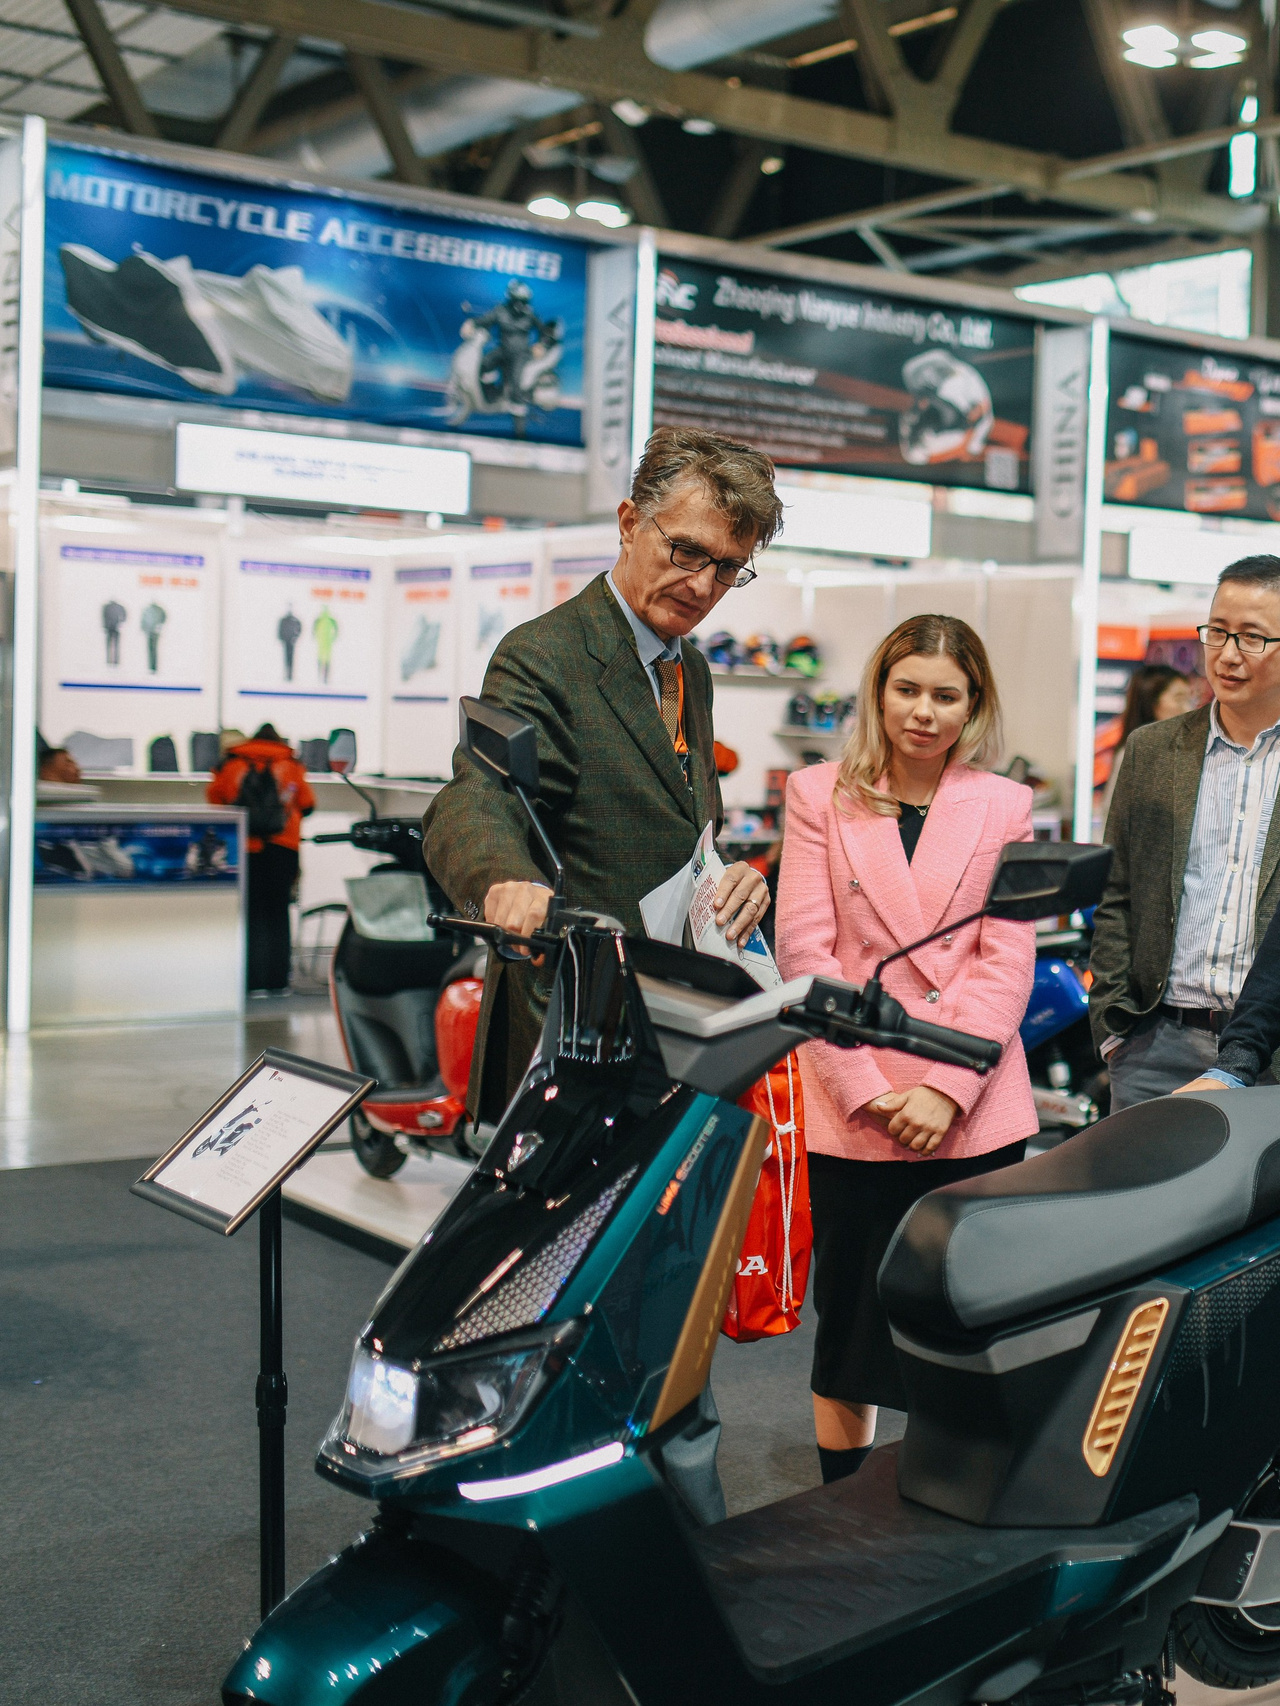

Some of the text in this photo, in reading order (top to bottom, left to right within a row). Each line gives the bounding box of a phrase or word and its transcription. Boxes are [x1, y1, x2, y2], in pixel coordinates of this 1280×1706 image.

[47, 171, 563, 282] MOTORCYCLE ACCESSORIES
[601, 297, 629, 468] CHINA
[1051, 369, 1080, 519] CHINA
[675, 1113, 721, 1182] SCOOTER
